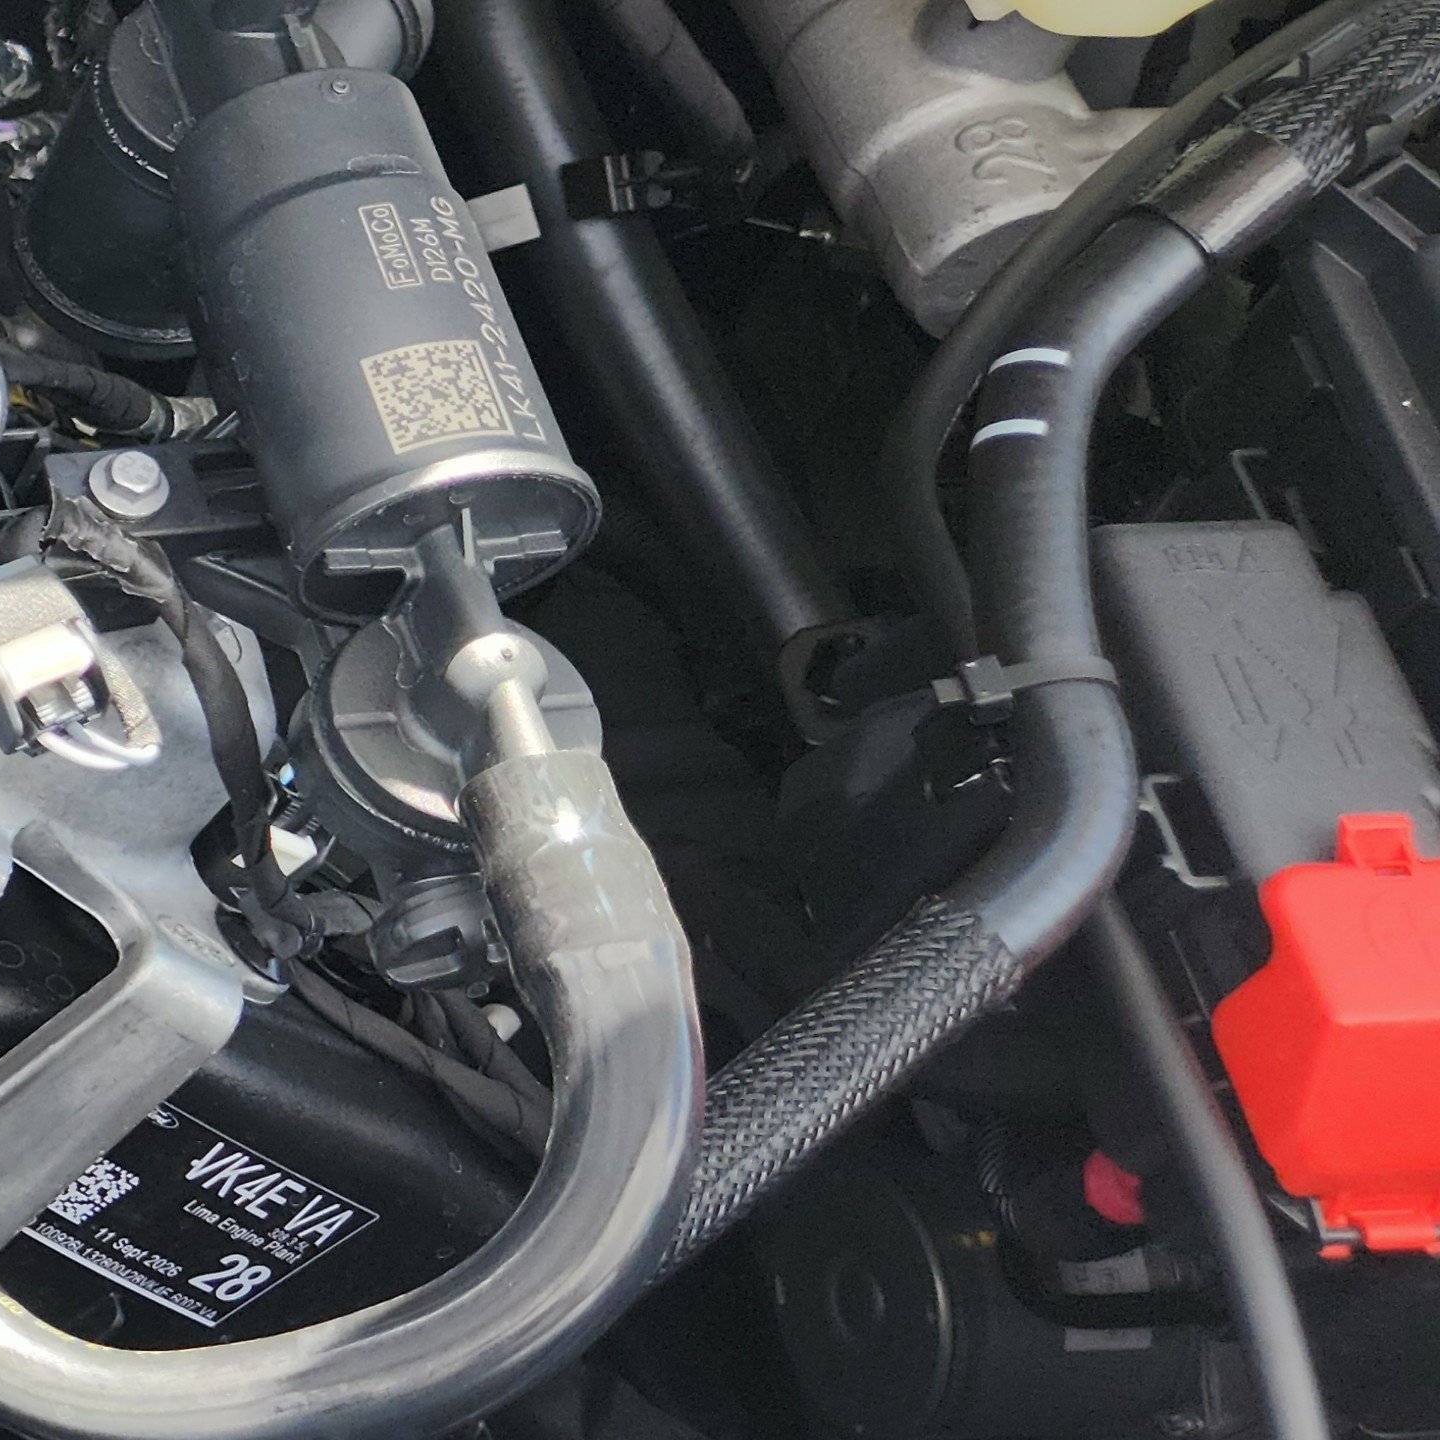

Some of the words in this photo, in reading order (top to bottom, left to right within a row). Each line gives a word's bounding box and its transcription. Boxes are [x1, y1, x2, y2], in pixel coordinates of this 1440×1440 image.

[368, 206, 417, 286] FoMoCo
[434, 195, 546, 443] LK41-2420-MG
[183, 1198, 217, 1223] Lima
[217, 1215, 261, 1248] Engine
[264, 1233, 304, 1265] Plant
[284, 1195, 354, 1247] VA
[94, 1227, 109, 1240] 11
[111, 1235, 144, 1263] Sept
[143, 1254, 182, 1279] 2026
[188, 1254, 271, 1302] 28
